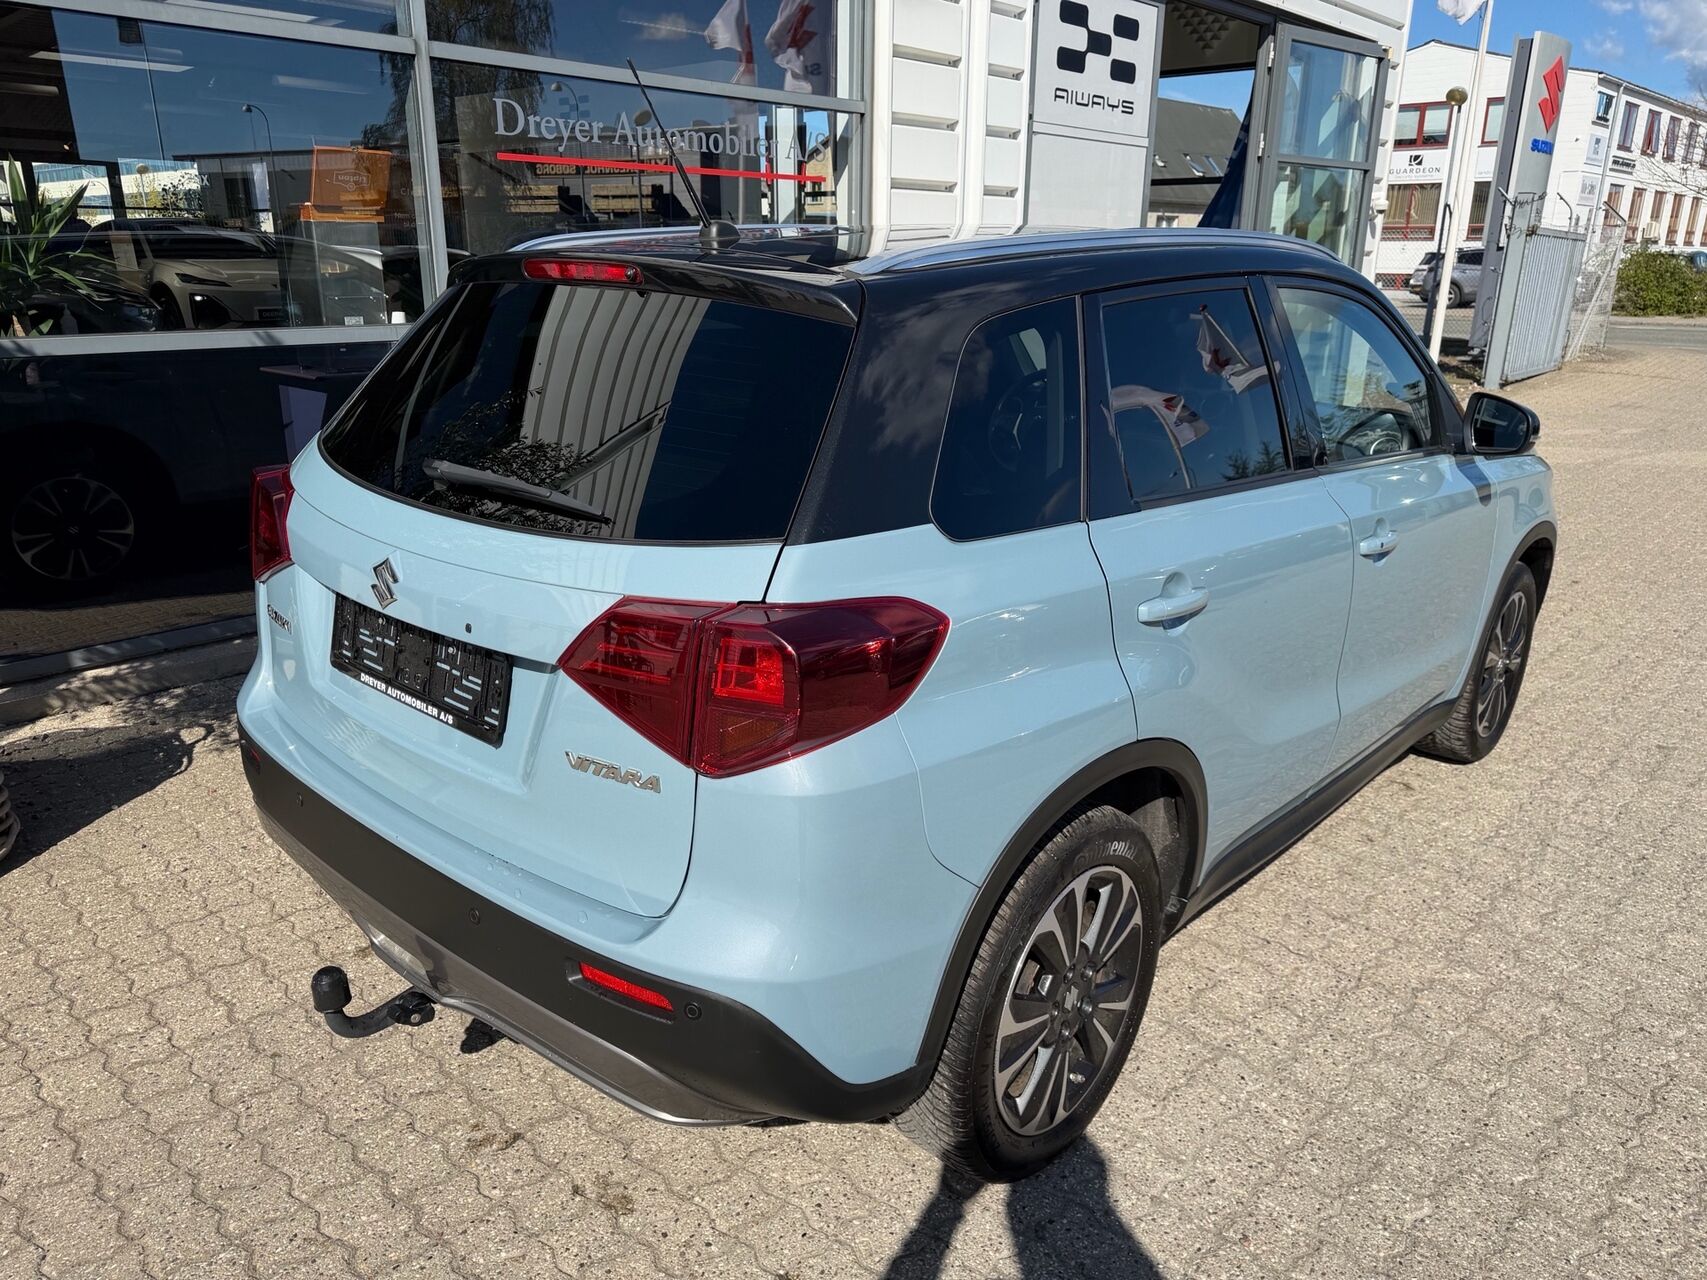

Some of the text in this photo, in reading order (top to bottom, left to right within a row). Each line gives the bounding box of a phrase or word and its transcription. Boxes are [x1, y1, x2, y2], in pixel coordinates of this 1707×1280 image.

[1054, 87, 1135, 115] AIWAYS
[492, 98, 828, 163] Dreyer Automobiler A/S
[1389, 166, 1440, 175] GUARDEON
[360, 672, 454, 724] DREYER AUTOMOBILER A/S
[564, 751, 661, 794] VITARA
